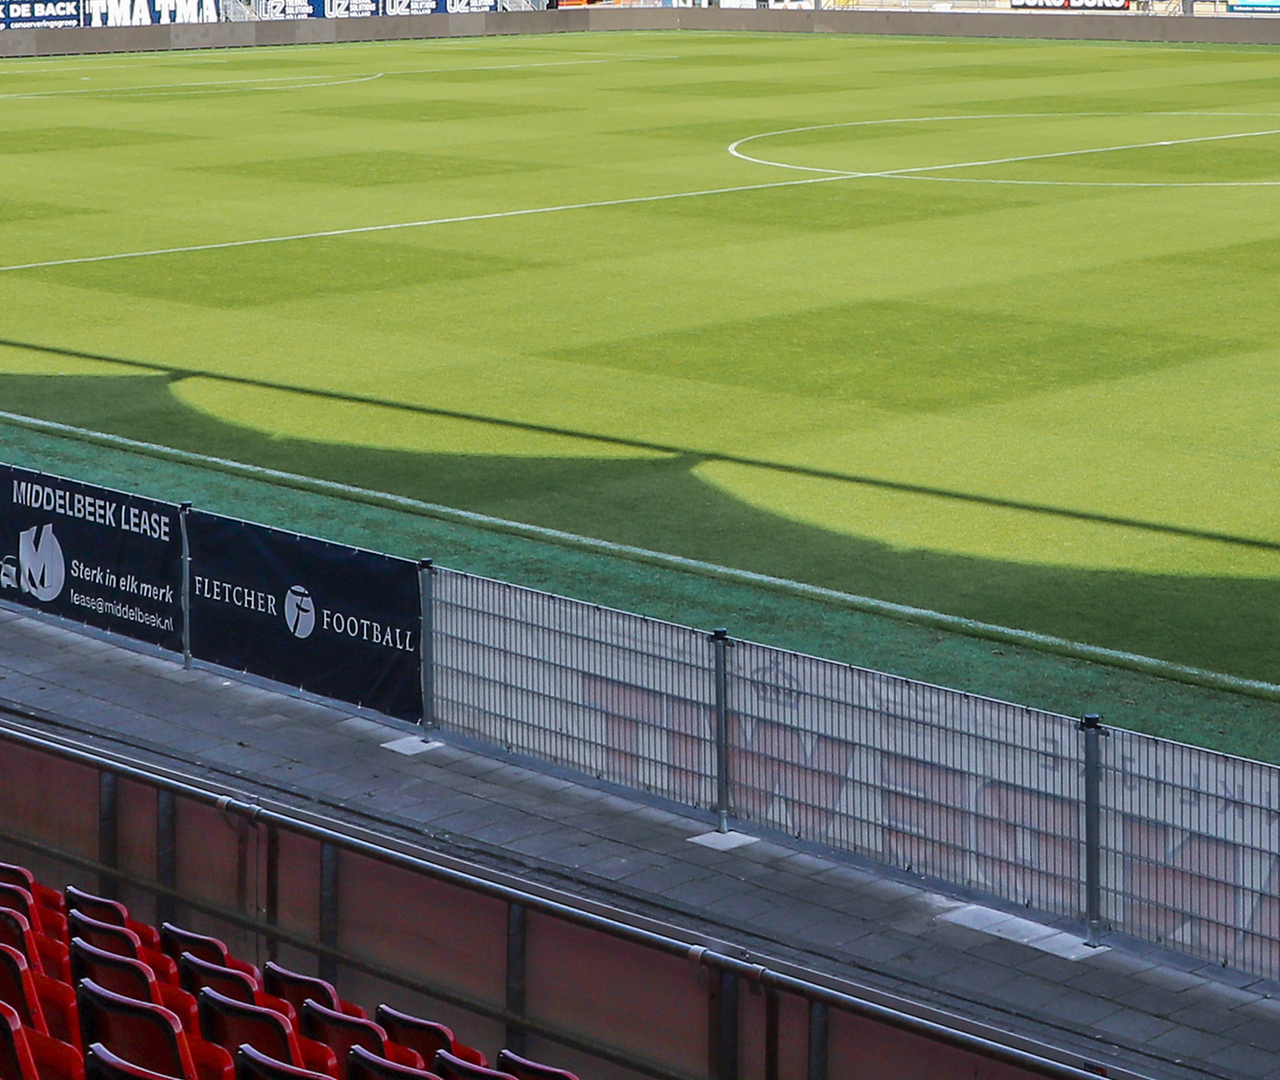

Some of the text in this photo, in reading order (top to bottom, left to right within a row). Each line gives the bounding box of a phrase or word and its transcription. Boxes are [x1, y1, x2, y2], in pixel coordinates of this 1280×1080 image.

[8, 1, 78, 19] DE BACK
[10, 19, 78, 30] conserveringsgroep
[12, 479, 171, 542] MIDDELBEEK LEASE
[70, 559, 174, 604] Sterk in elk merk
[70, 588, 175, 632] lease@middelbeek.nl
[194, 575, 416, 653] FLETCHER FOOTBALL
